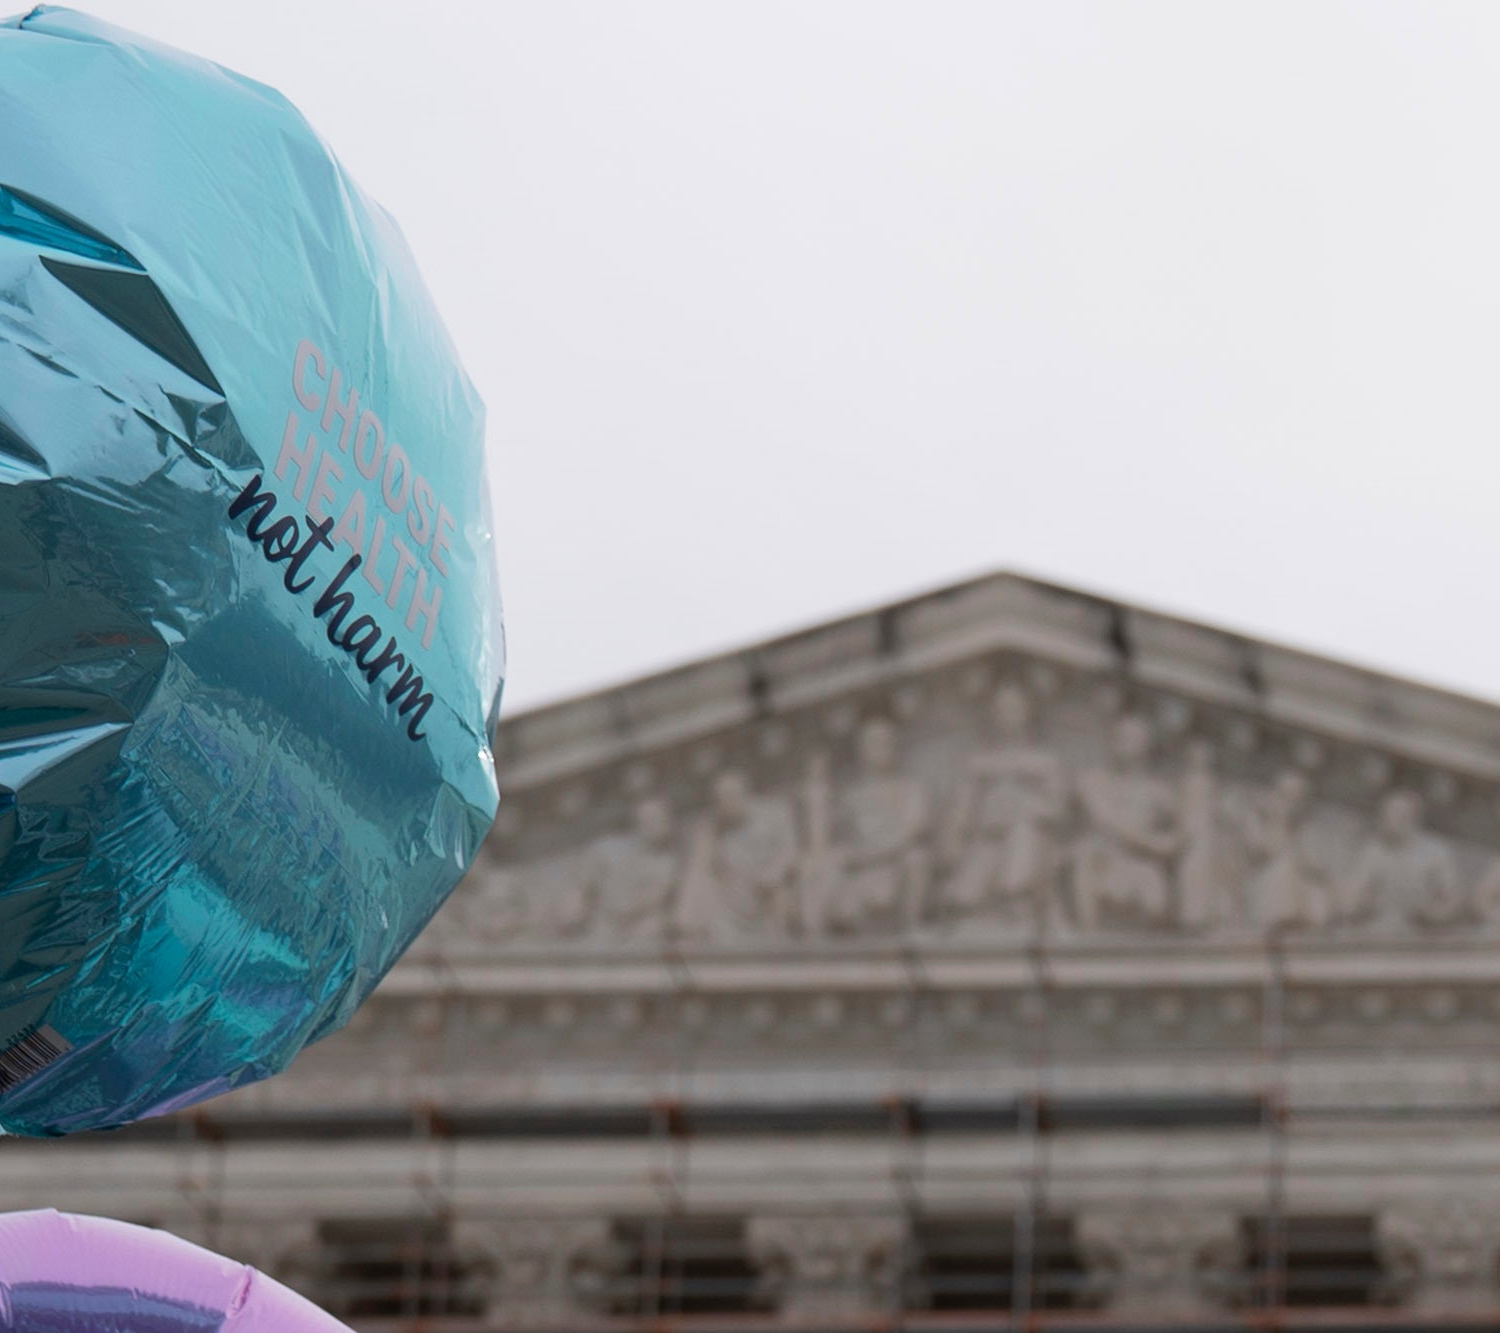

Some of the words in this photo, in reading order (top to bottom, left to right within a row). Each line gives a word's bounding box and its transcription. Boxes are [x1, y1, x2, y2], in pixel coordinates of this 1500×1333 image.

[273, 410, 443, 651] HEALTH
[292, 338, 456, 578] CHOOSE
[228, 474, 335, 594] not
[313, 553, 434, 742] harm
